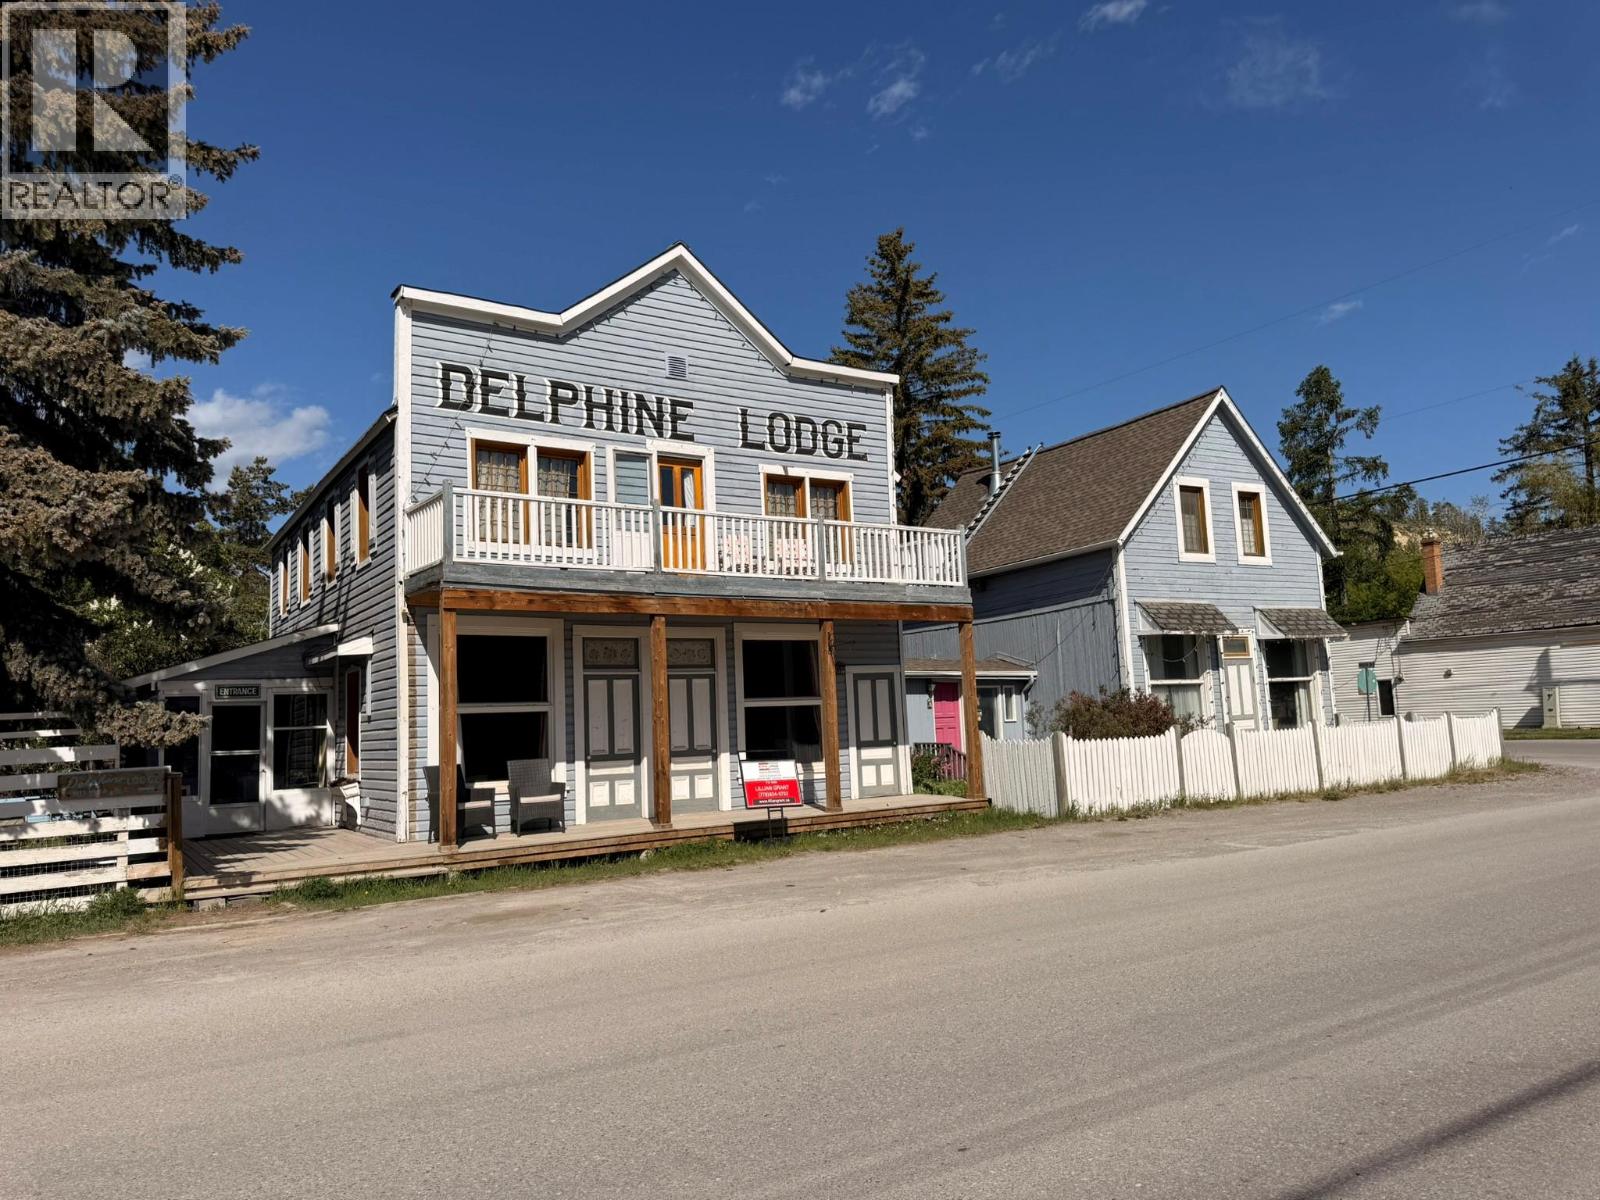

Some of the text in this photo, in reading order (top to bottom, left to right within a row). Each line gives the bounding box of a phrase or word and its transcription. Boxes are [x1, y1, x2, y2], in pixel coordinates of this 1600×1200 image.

[436, 360, 869, 462] DELPHINE LODGE
[219, 687, 257, 696] ENTRANCE
